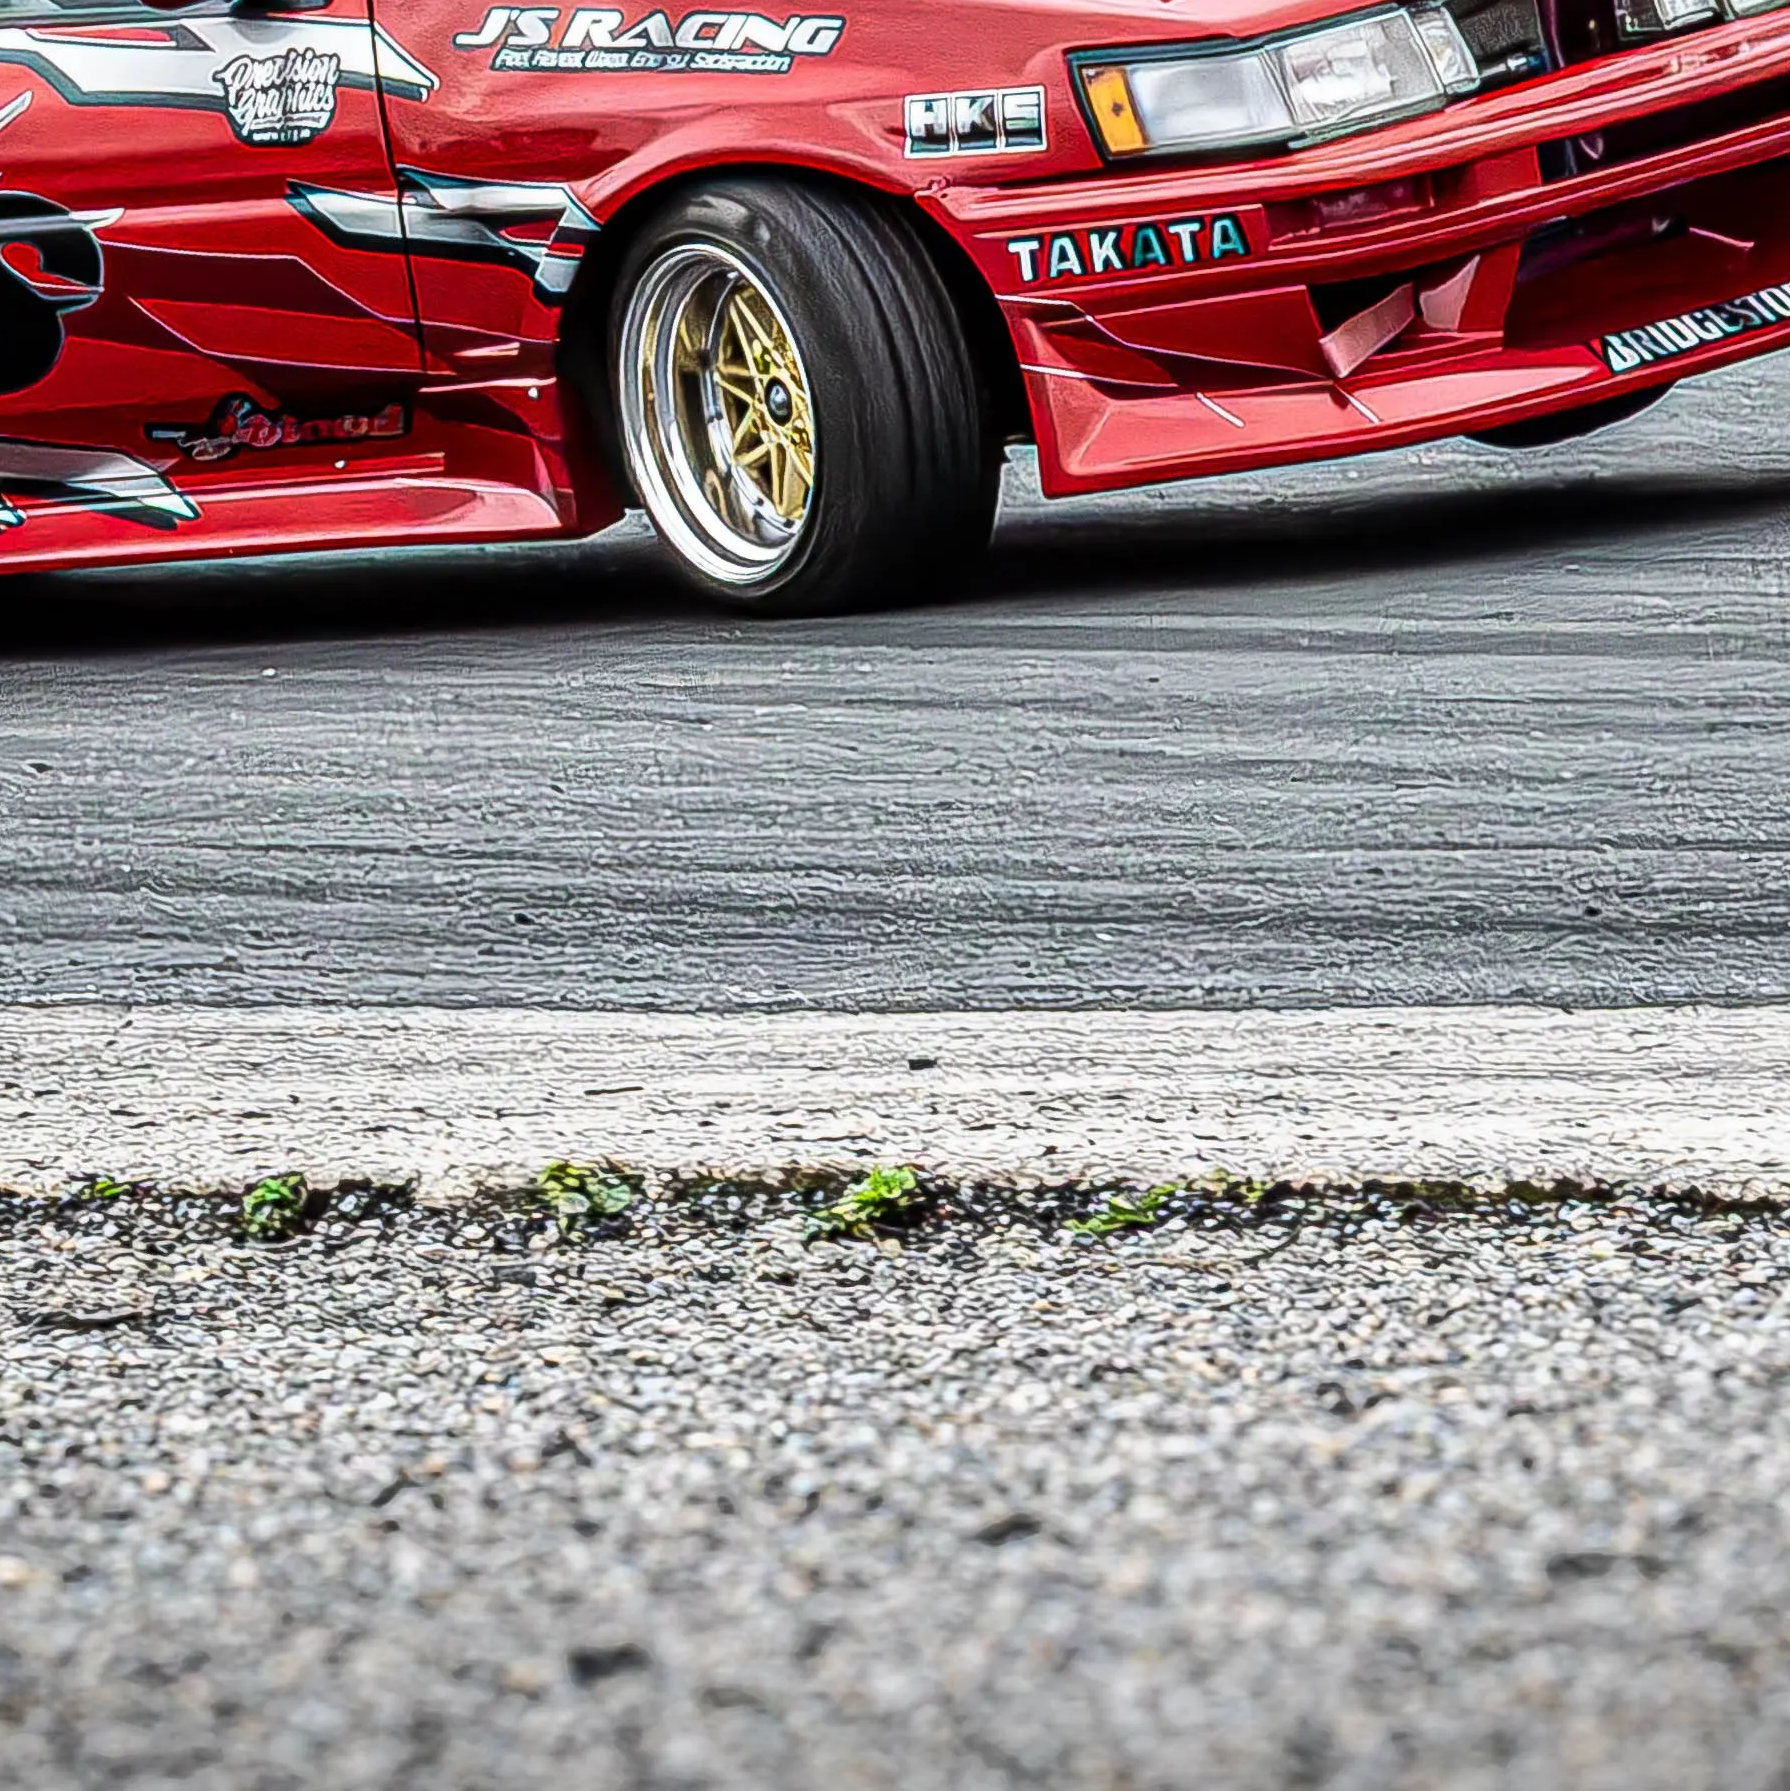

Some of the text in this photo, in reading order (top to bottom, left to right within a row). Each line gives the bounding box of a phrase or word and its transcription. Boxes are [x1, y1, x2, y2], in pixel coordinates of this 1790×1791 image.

[562, 9, 842, 54] RACING
[909, 92, 1041, 137] HKS
[1008, 219, 1245, 282] TAKATA
